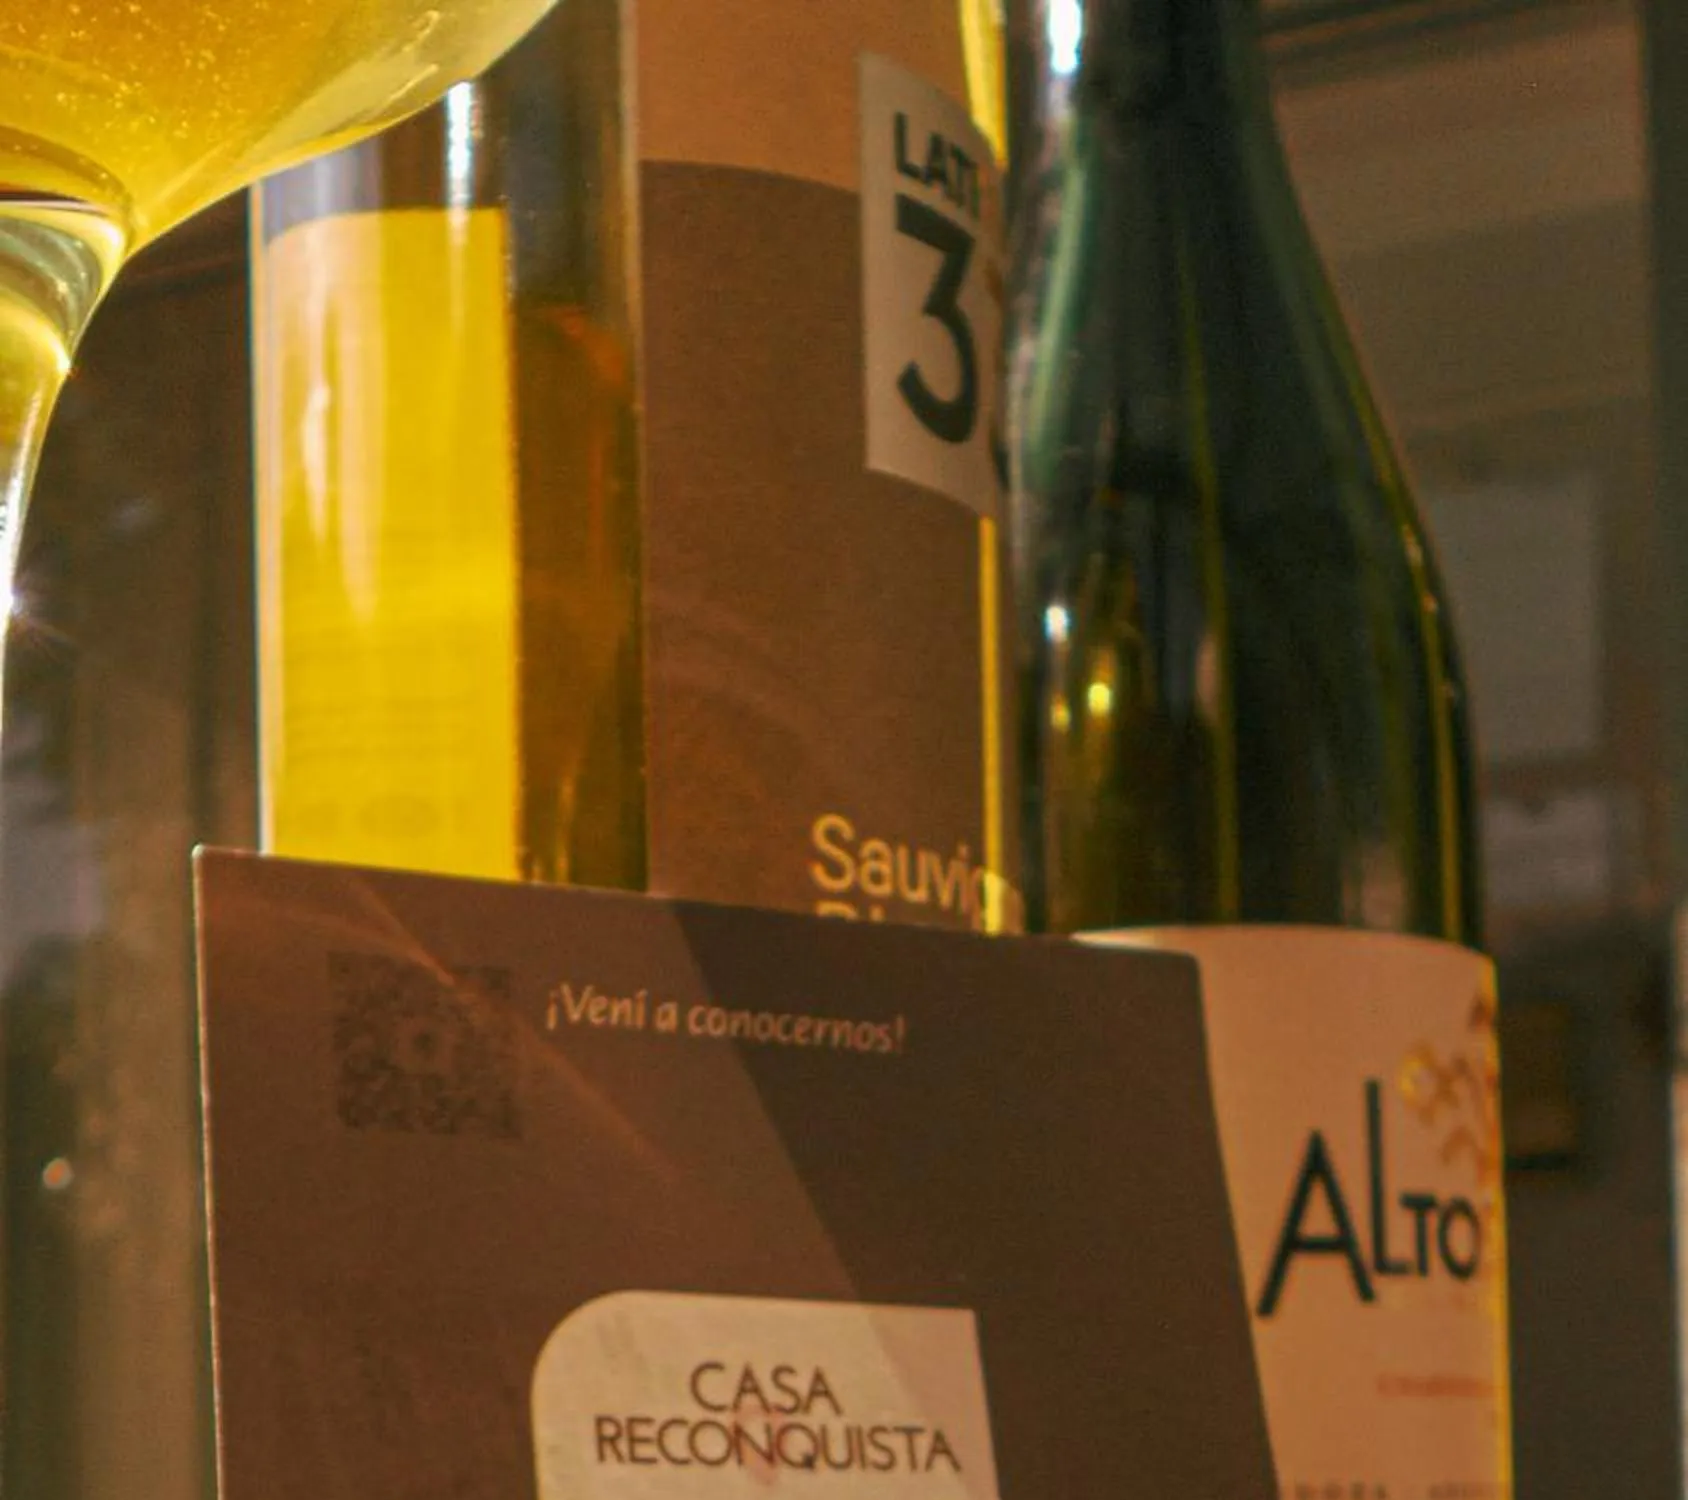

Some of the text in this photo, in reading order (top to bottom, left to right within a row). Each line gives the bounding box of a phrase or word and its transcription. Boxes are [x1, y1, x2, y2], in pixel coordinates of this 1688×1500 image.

[896, 193, 1008, 490] 3
[655, 1000, 679, 1033] a
[687, 1004, 906, 1054] conocernos!
[690, 1361, 844, 1416] CASA
[594, 1415, 962, 1473] RECONQUISTA
